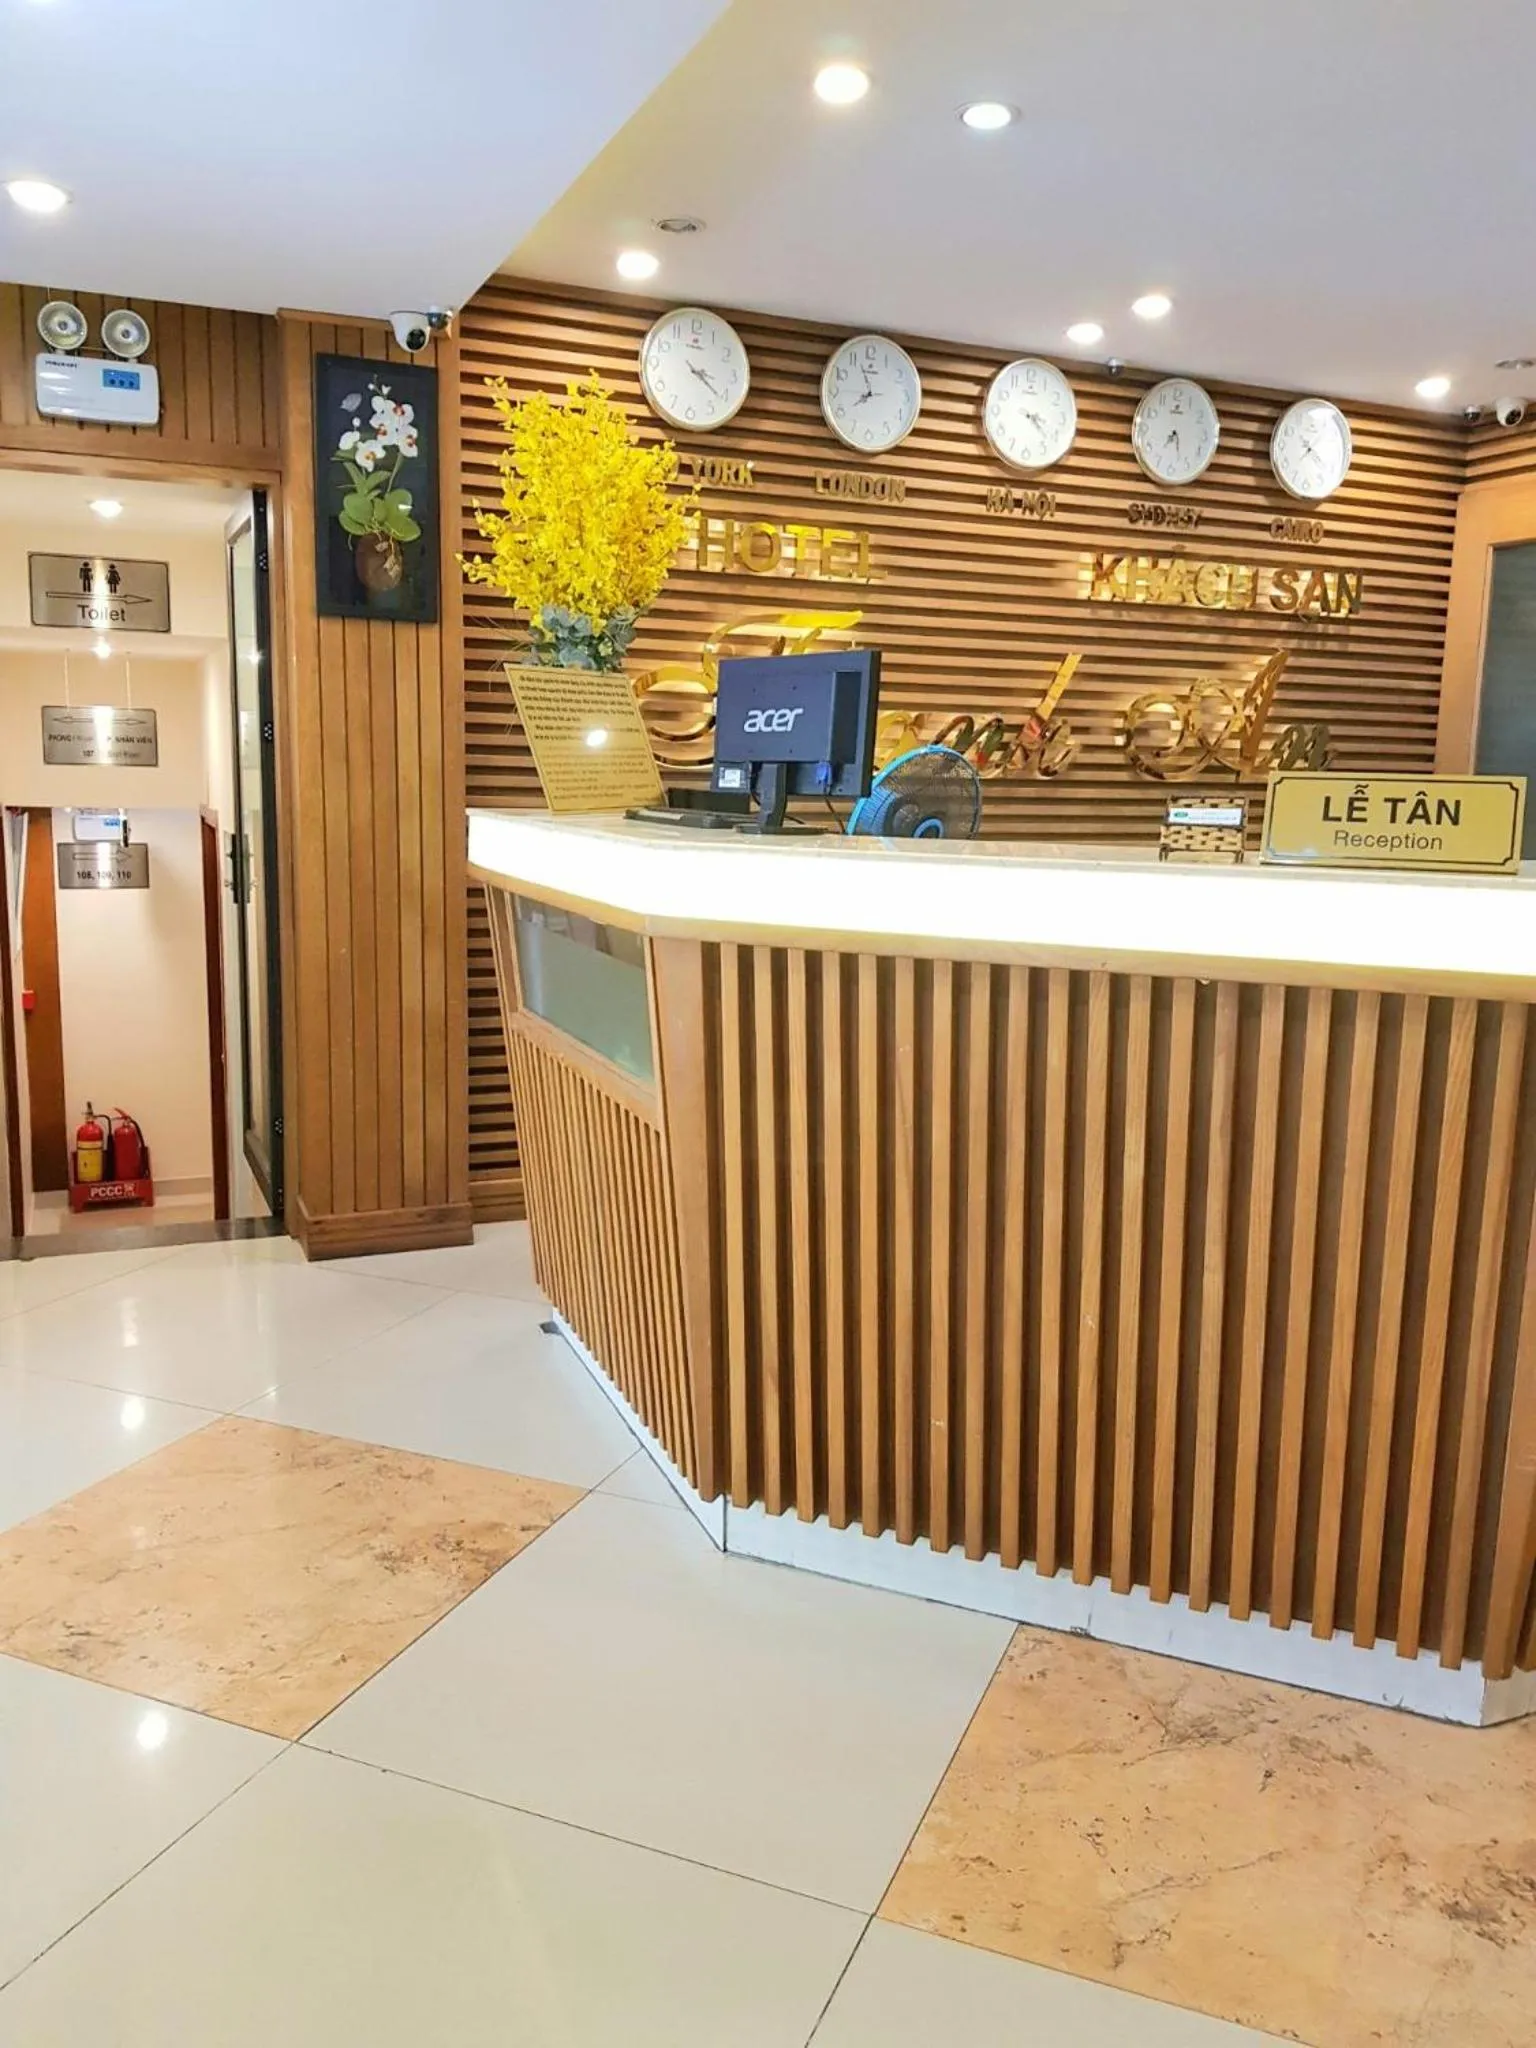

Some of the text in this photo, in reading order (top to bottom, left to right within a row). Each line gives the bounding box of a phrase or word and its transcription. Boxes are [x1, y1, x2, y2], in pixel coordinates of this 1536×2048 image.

[689, 456, 755, 488] YORK
[813, 470, 907, 503] LONDON
[1269, 517, 1325, 544] CAIRO
[697, 517, 889, 580] HOTEL
[77, 603, 126, 622] Toilet
[743, 707, 805, 734] acer
[1321, 783, 1462, 827] LỄ TÂN
[1333, 829, 1443, 853] Reception
[90, 1185, 123, 1198] PCCC
